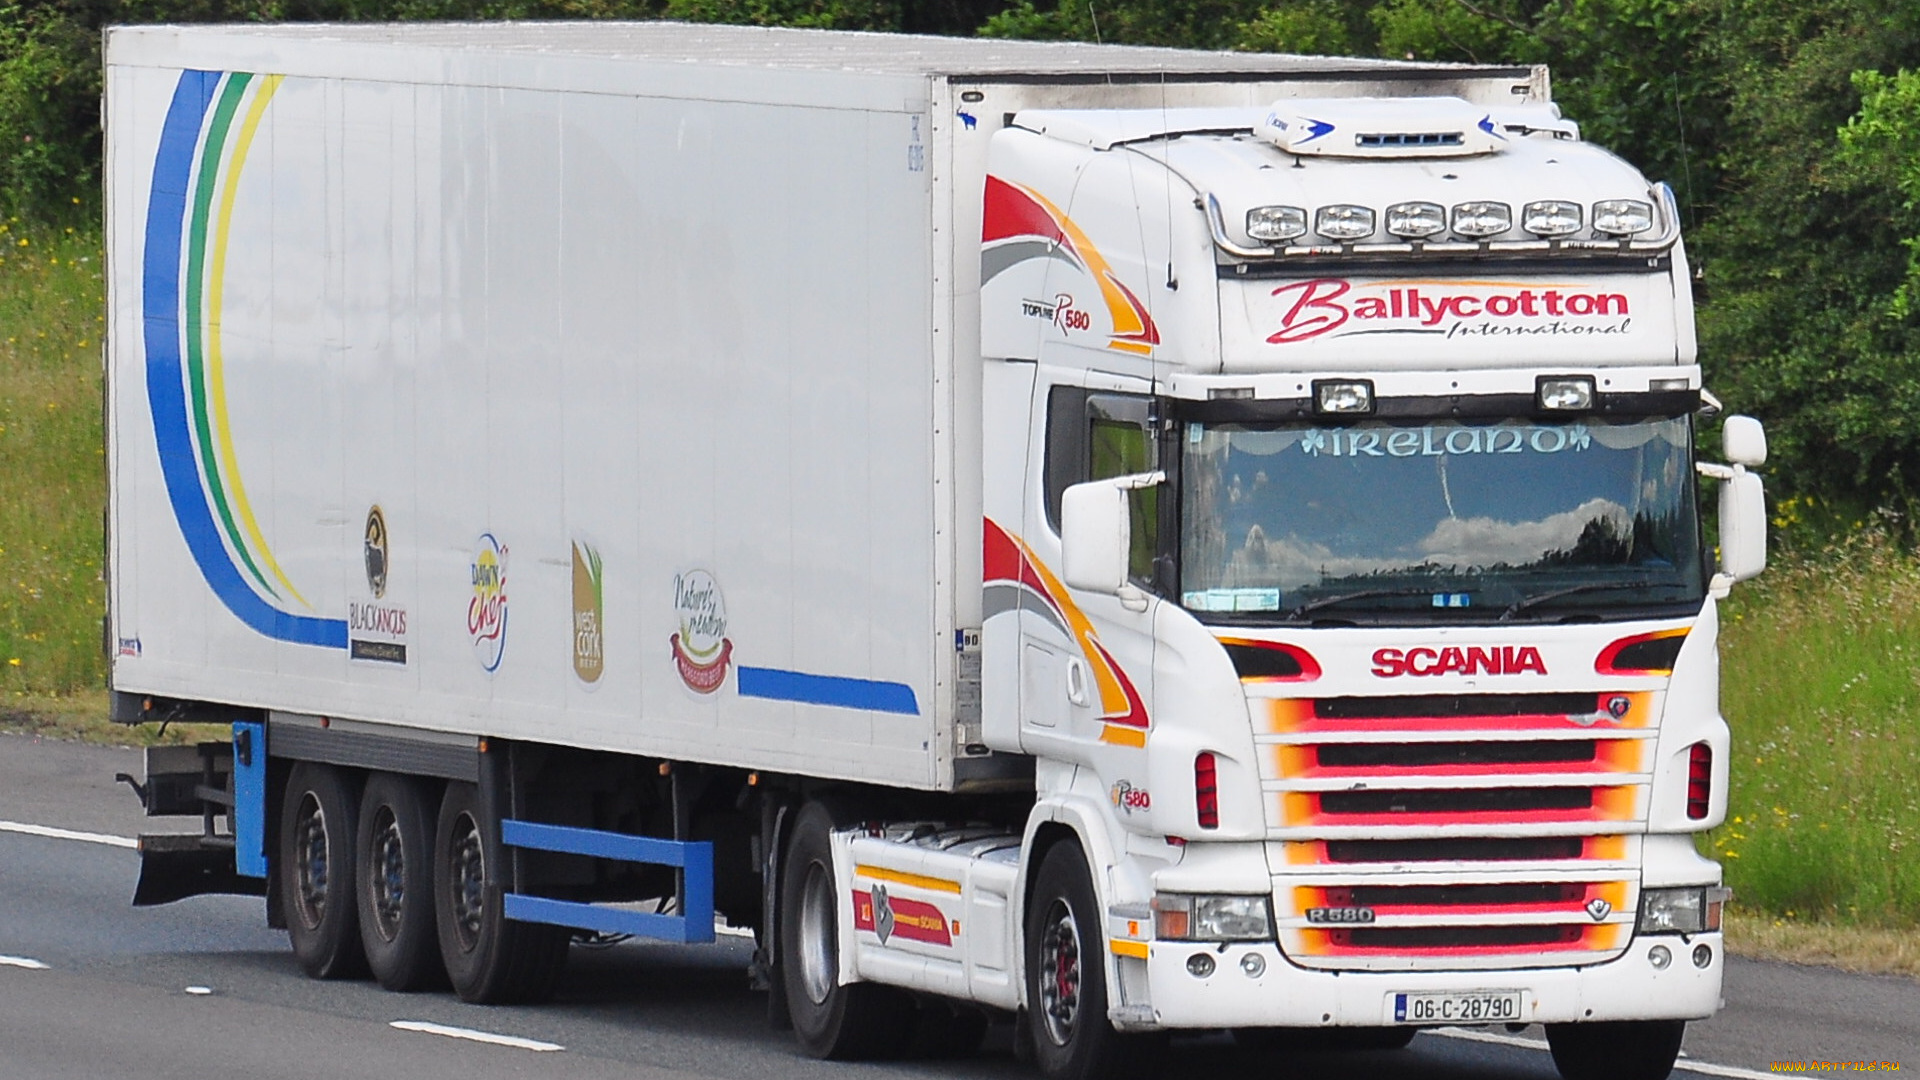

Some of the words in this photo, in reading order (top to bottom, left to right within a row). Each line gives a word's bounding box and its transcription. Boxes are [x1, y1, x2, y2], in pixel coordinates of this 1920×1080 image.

[1266, 279, 1629, 344] Ballycotton
[1446, 317, 1632, 339] International
[472, 563, 499, 588] DAWN
[1371, 645, 1548, 677] SCANIA
[1414, 998, 1513, 1019] 06-C-28790
